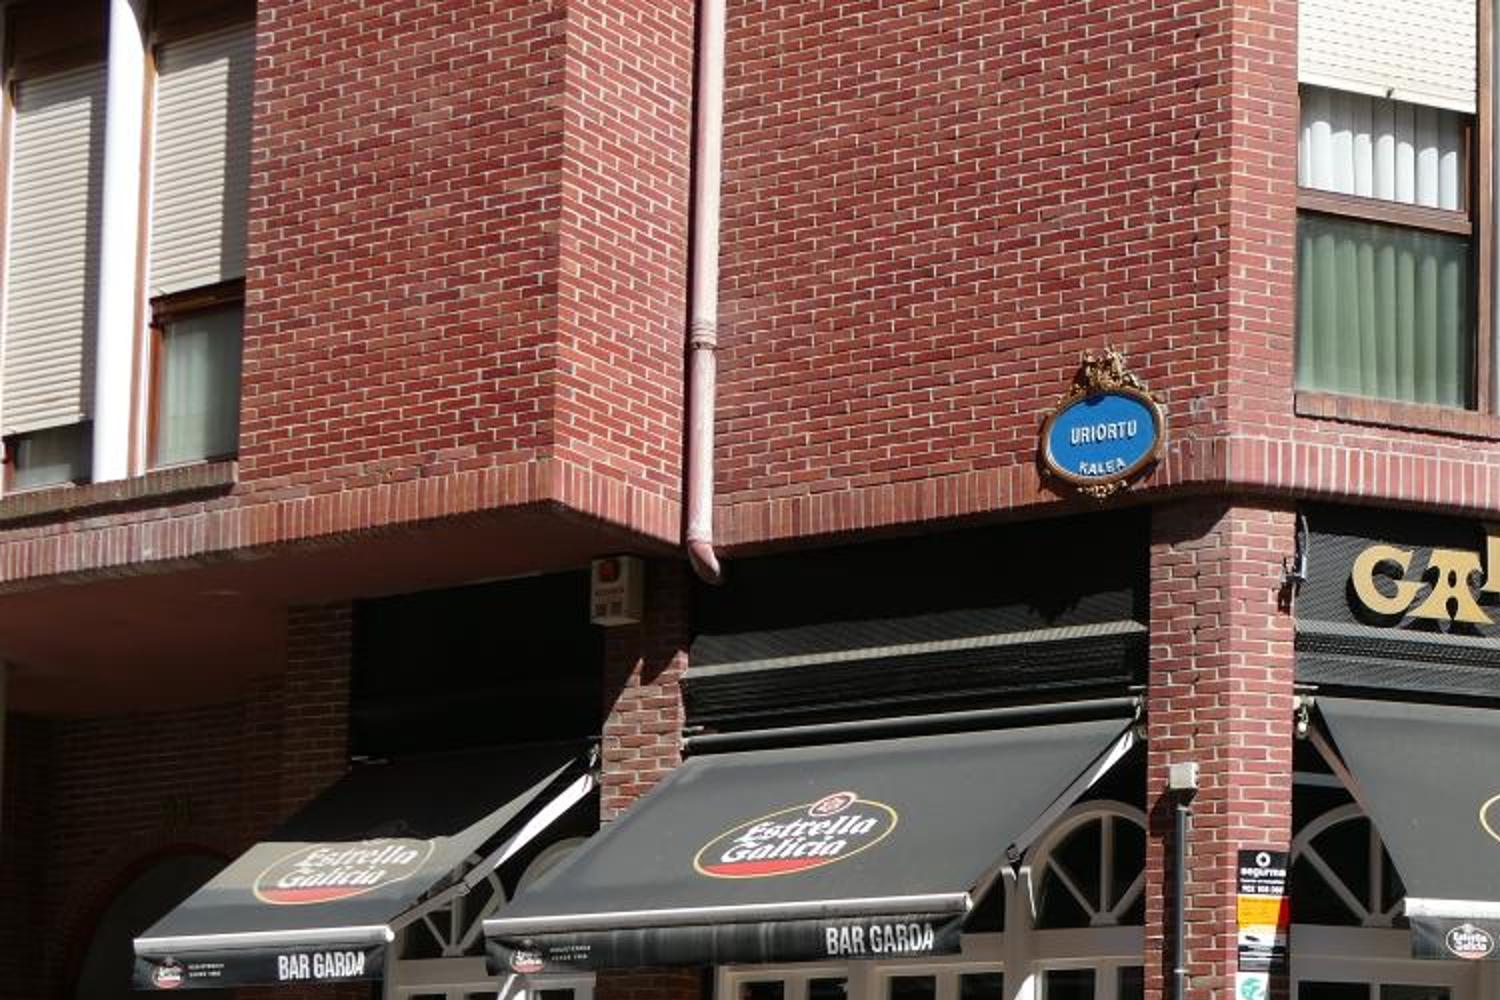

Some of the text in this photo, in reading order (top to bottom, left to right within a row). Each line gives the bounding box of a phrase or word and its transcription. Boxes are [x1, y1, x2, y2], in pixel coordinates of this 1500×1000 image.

[1071, 419, 1137, 444] URIORTU
[1079, 457, 1126, 475] KALEA
[733, 815, 879, 843] Estrella
[294, 845, 419, 867] Estrella
[720, 835, 848, 863] Galicia
[277, 866, 387, 888] Galicia
[825, 922, 935, 955] BAR GAROA
[277, 954, 311, 981] BAR
